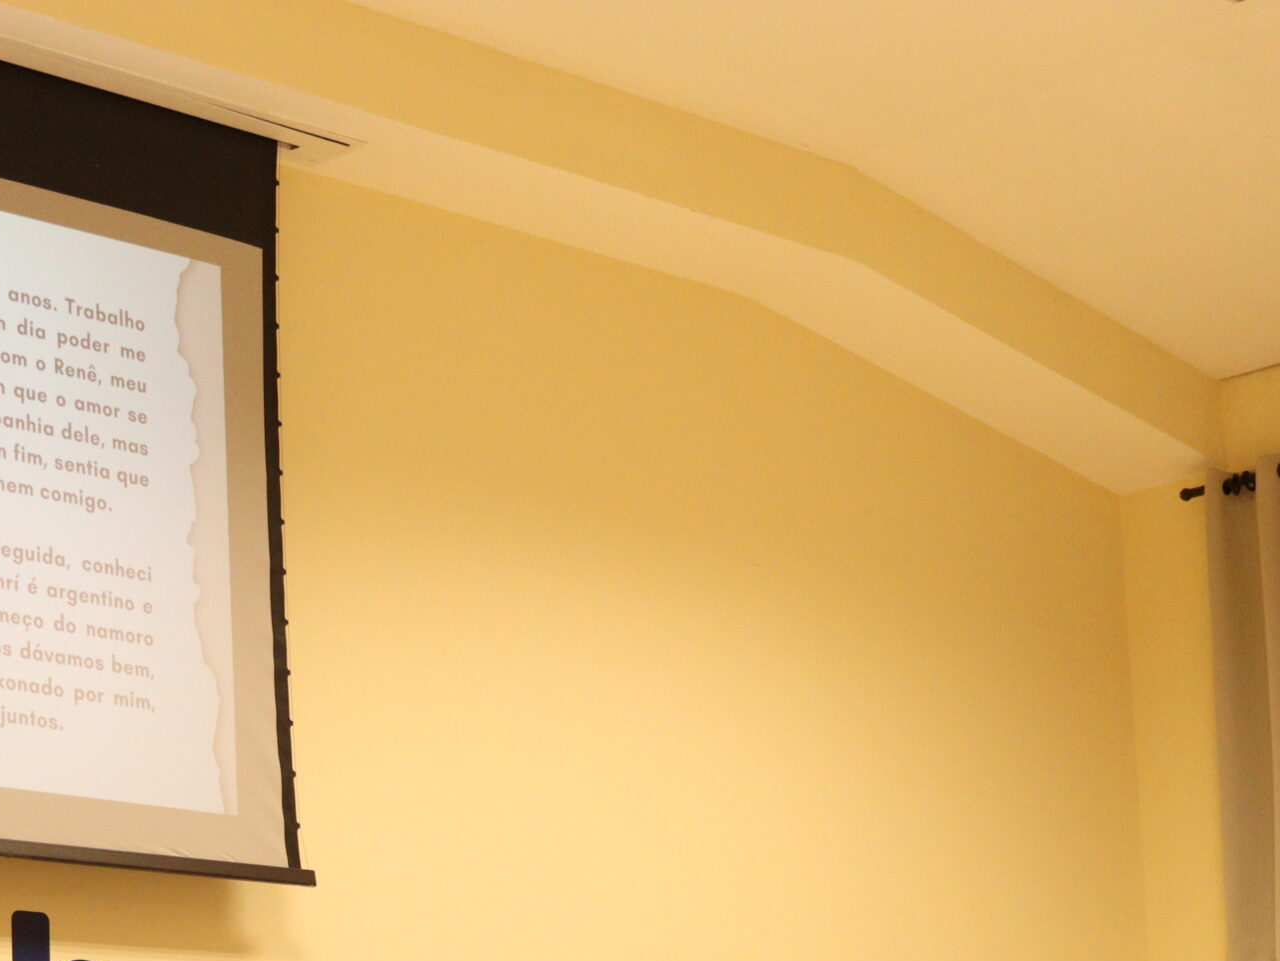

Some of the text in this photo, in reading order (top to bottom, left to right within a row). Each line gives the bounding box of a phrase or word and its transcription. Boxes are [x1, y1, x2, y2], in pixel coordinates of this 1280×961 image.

[8, 289, 58, 312] anos.
[64, 296, 146, 333] Trabalho
[17, 316, 47, 341] dia
[57, 331, 111, 355] poder
[120, 345, 147, 363] me
[35, 358, 47, 372] o
[54, 356, 103, 387] Renê,
[110, 374, 147, 394] meu
[13, 385, 48, 405] que
[56, 394, 67, 408] o
[74, 398, 121, 419] amor
[128, 409, 148, 425] se
[61, 421, 106, 450] dele,
[112, 437, 149, 457] mas
[13, 442, 48, 471] fim,
[54, 457, 111, 480] sentia
[117, 469, 150, 489] que
[40, 486, 113, 514] comigo.
[82, 557, 152, 582] conheci
[28, 576, 38, 595] é
[47, 585, 135, 612] argentino
[143, 601, 153, 615] e
[54, 613, 77, 635] do
[87, 623, 154, 647] namoro
[20, 640, 105, 671] dávamos
[112, 653, 155, 679] bem,
[0, 705, 64, 731] juntos.
[74, 687, 105, 705] por
[114, 691, 155, 713] mim,
